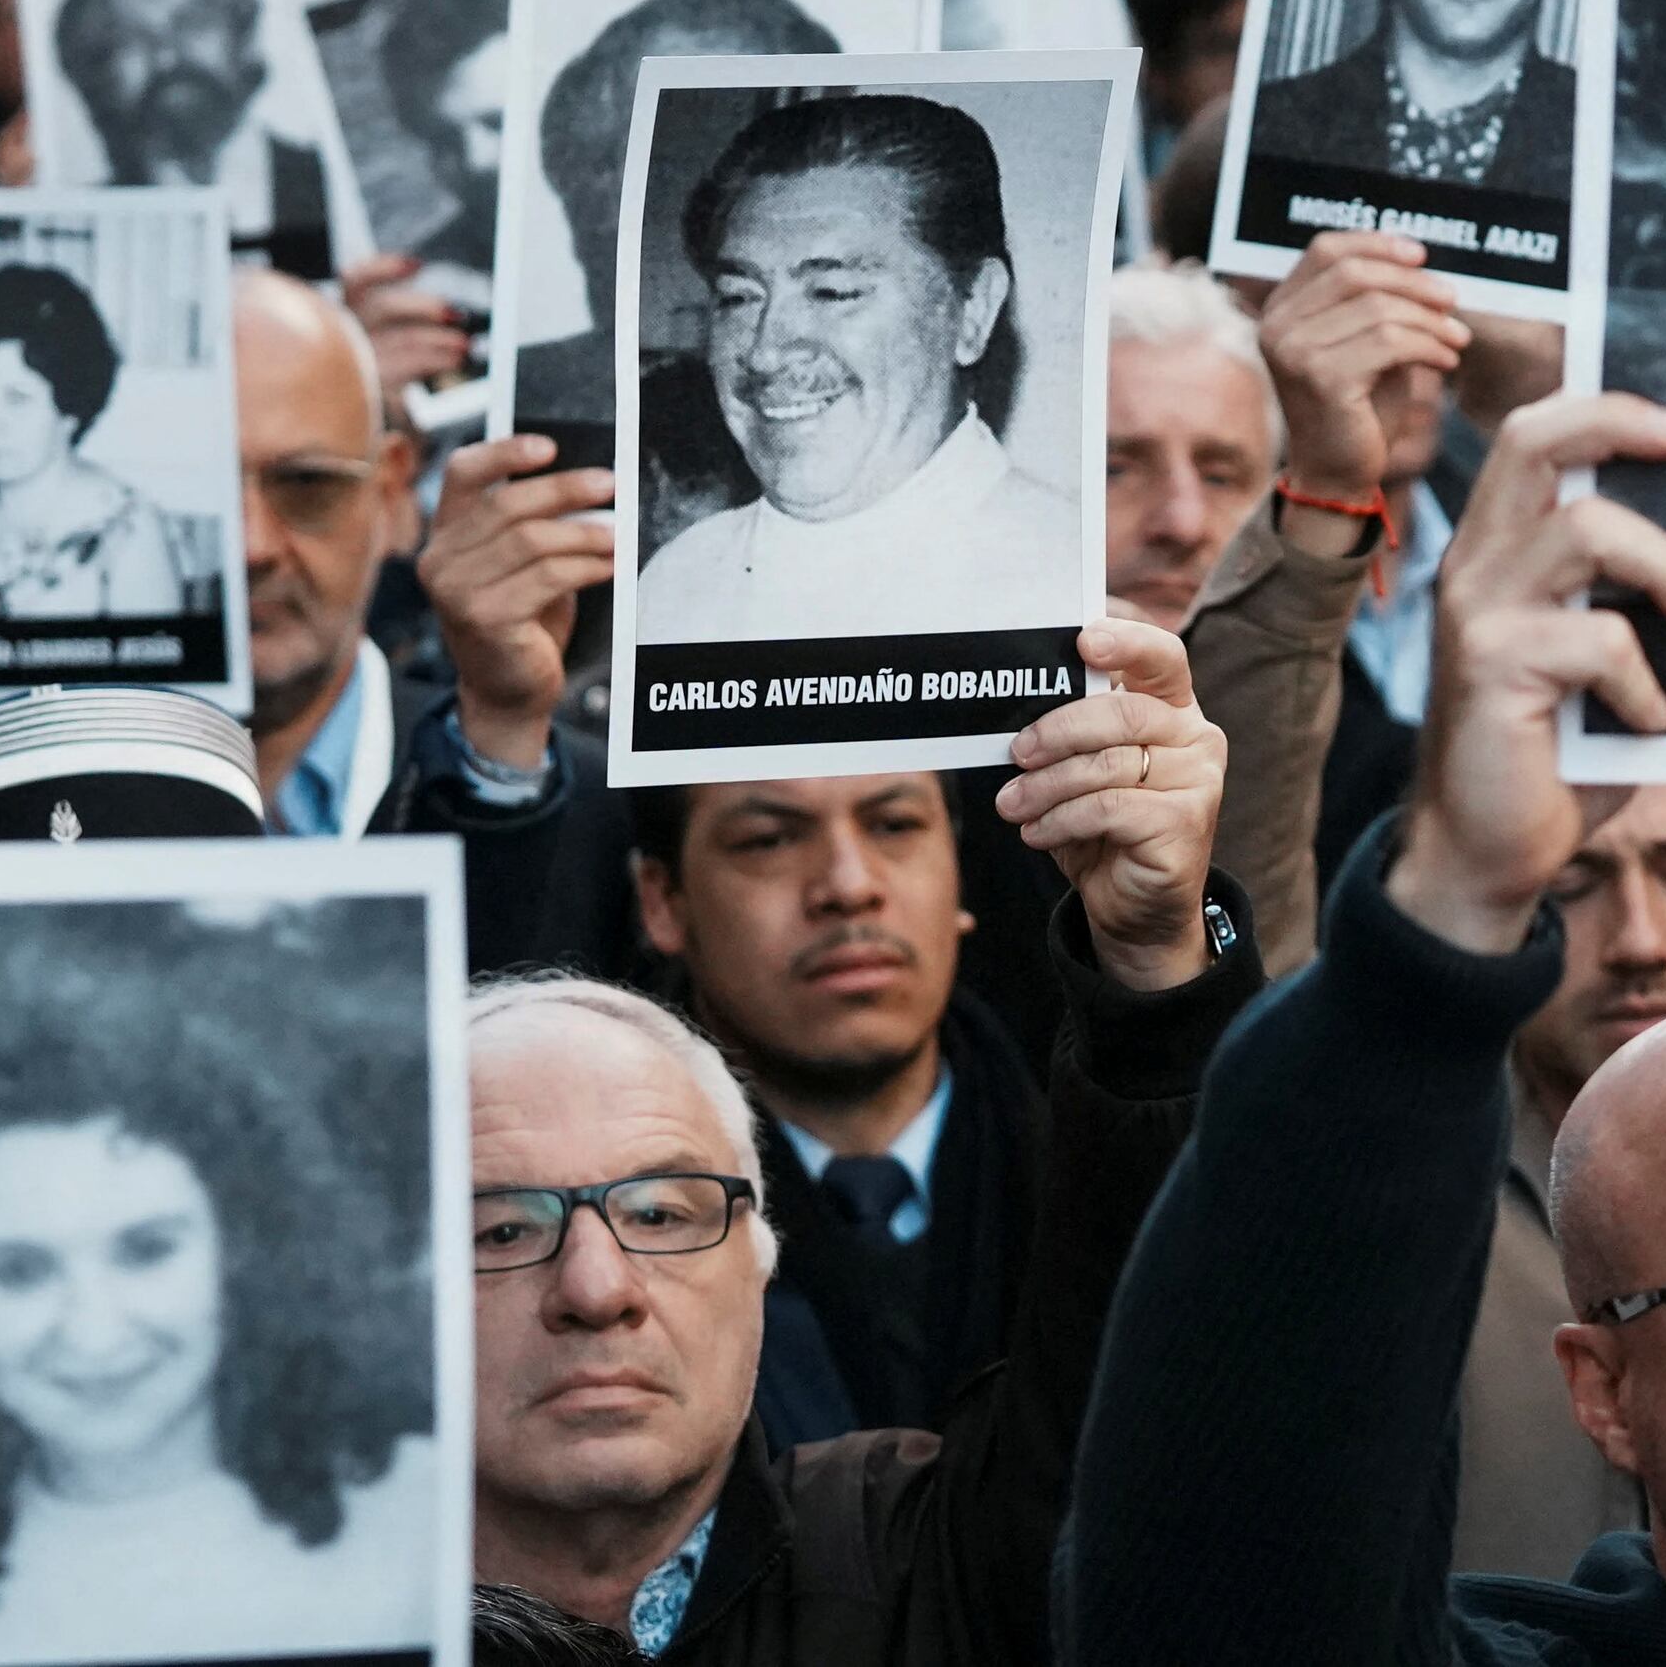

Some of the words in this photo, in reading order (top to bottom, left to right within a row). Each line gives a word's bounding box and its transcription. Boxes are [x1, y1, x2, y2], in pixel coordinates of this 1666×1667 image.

[1287, 195, 1378, 232] MOISÉS
[1379, 207, 1480, 251] GABRIEL
[1484, 224, 1559, 264] ARAZI
[649, 680, 758, 712] CARLOS
[764, 668, 913, 707] AVENDAÑO
[921, 667, 1072, 701] BOBADILLA
